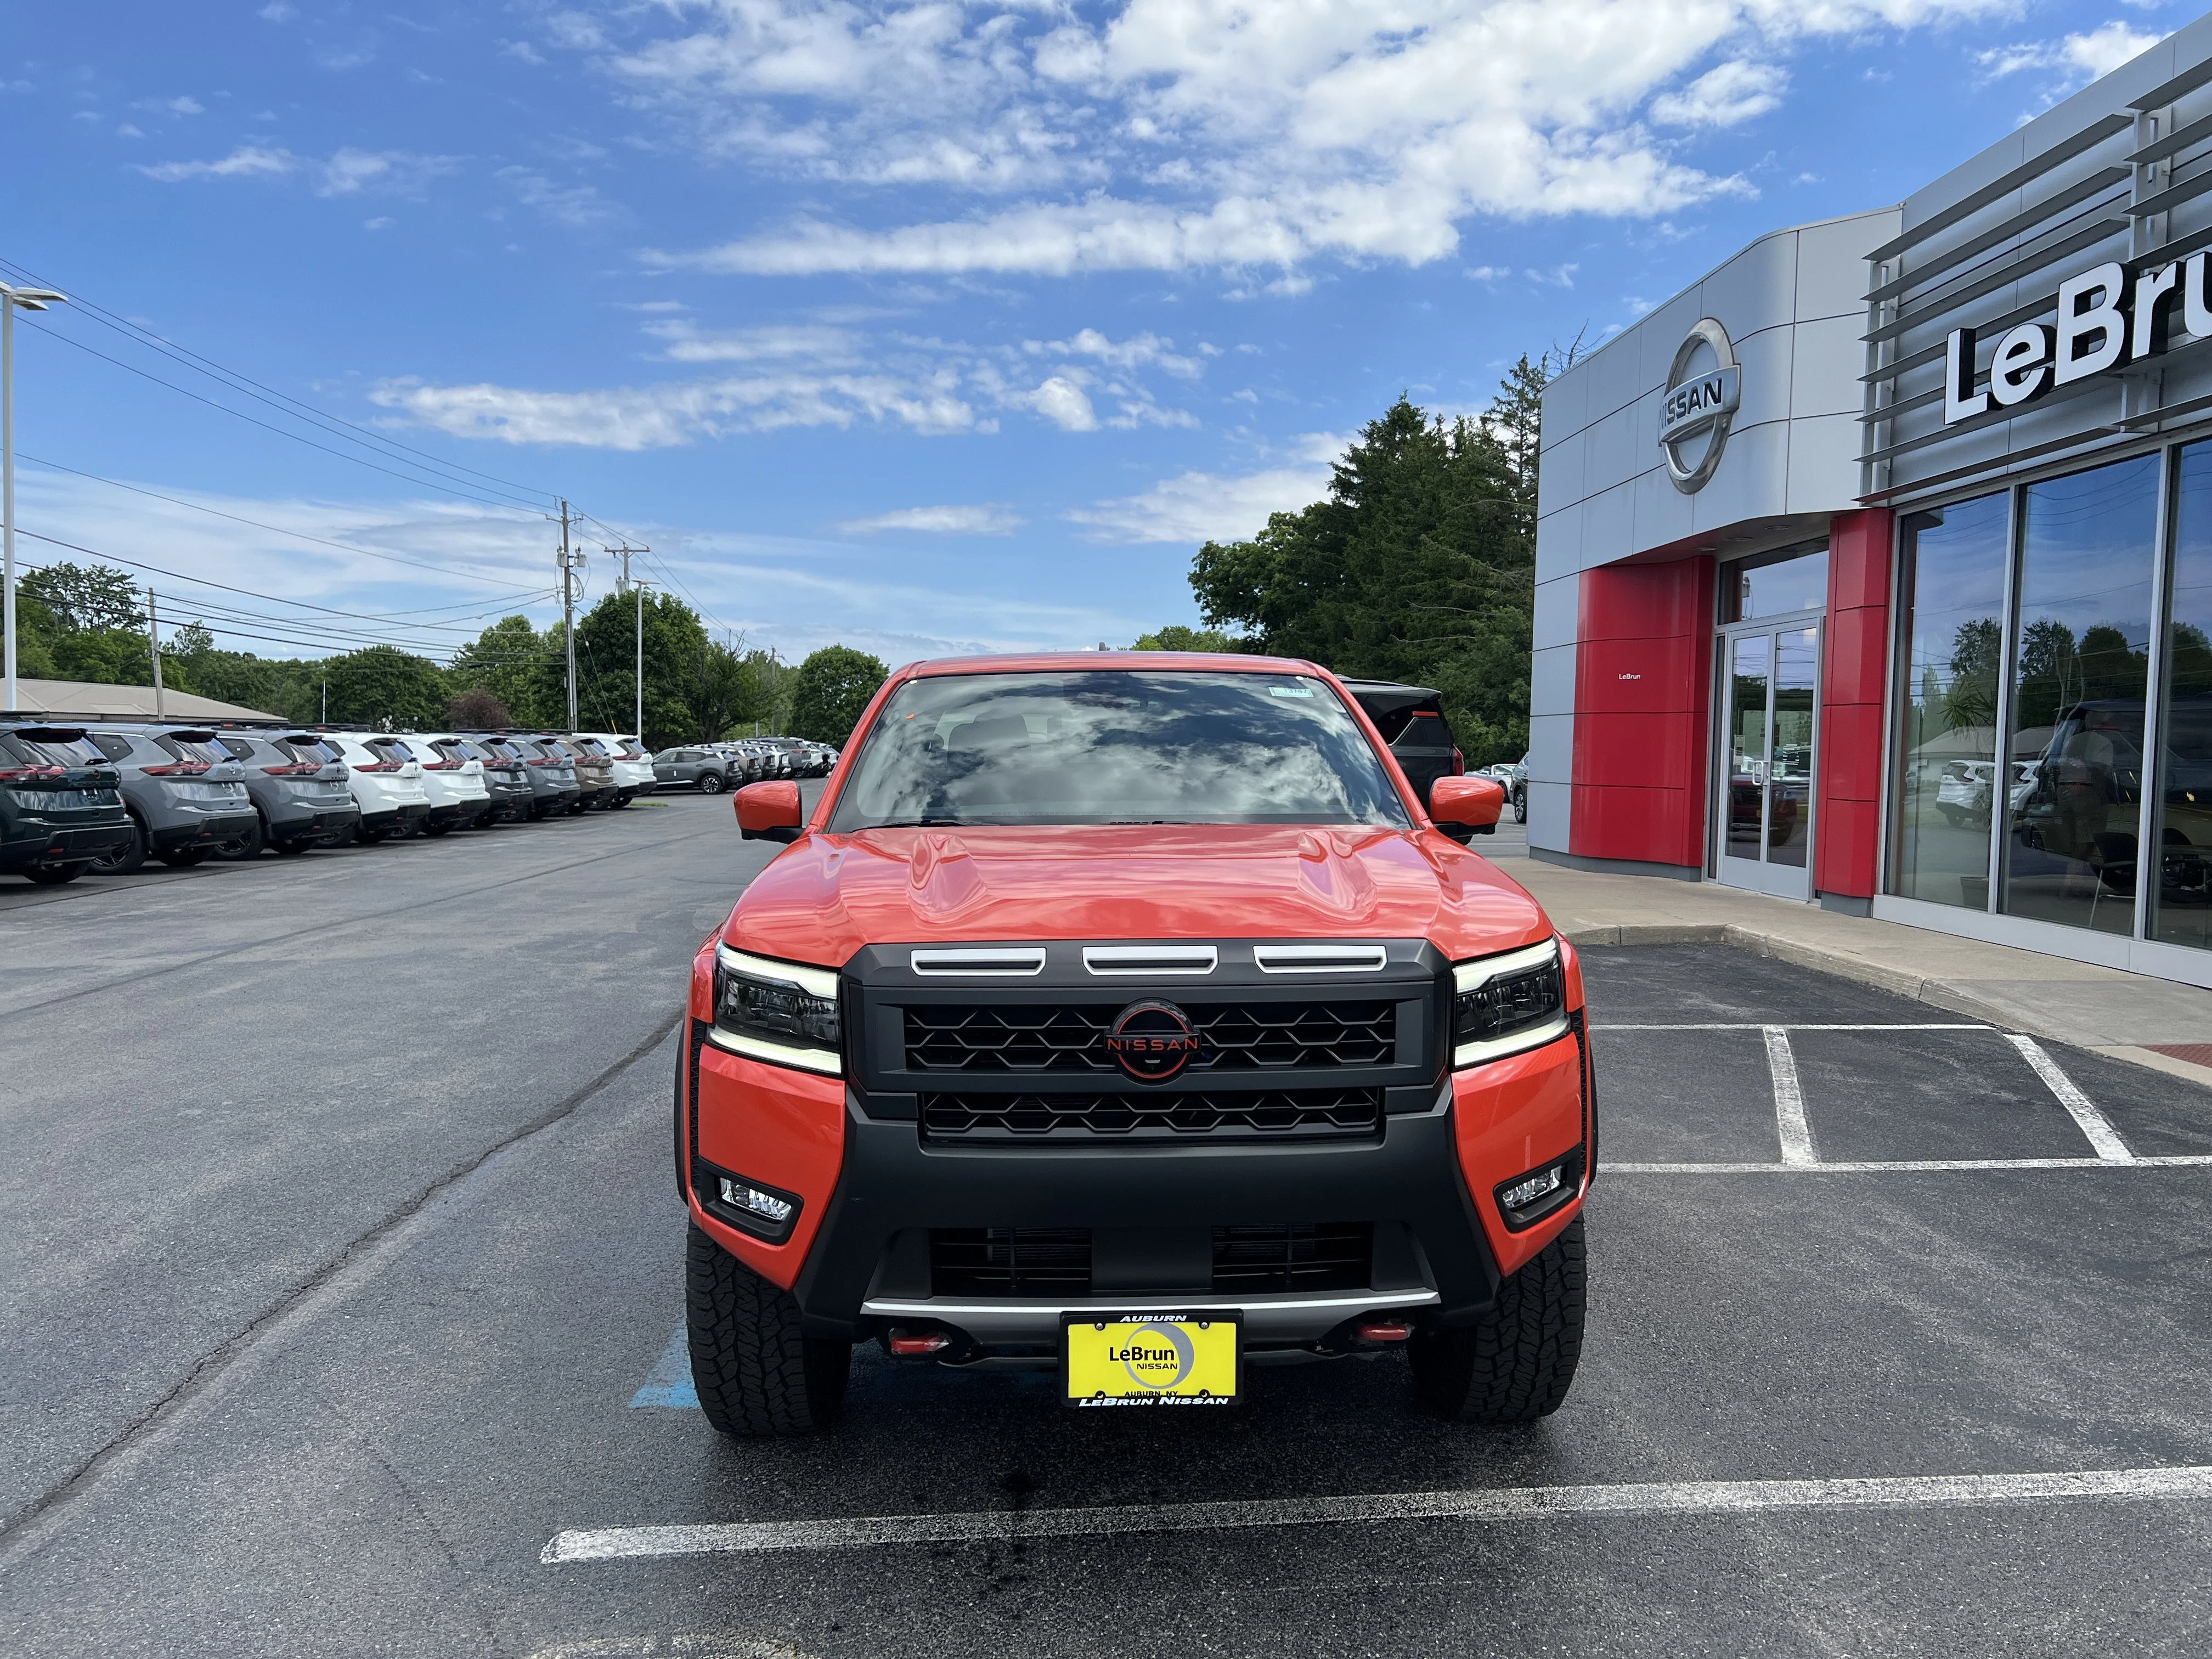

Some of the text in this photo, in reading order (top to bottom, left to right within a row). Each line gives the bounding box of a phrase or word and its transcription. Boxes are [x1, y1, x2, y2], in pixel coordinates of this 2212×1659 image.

[1660, 377, 1722, 429] NISSAN
[1107, 1037, 1199, 1051] NISSAN
[1120, 1314, 1187, 1323] AUBURN
[1109, 1346, 1175, 1362] LeBrun
